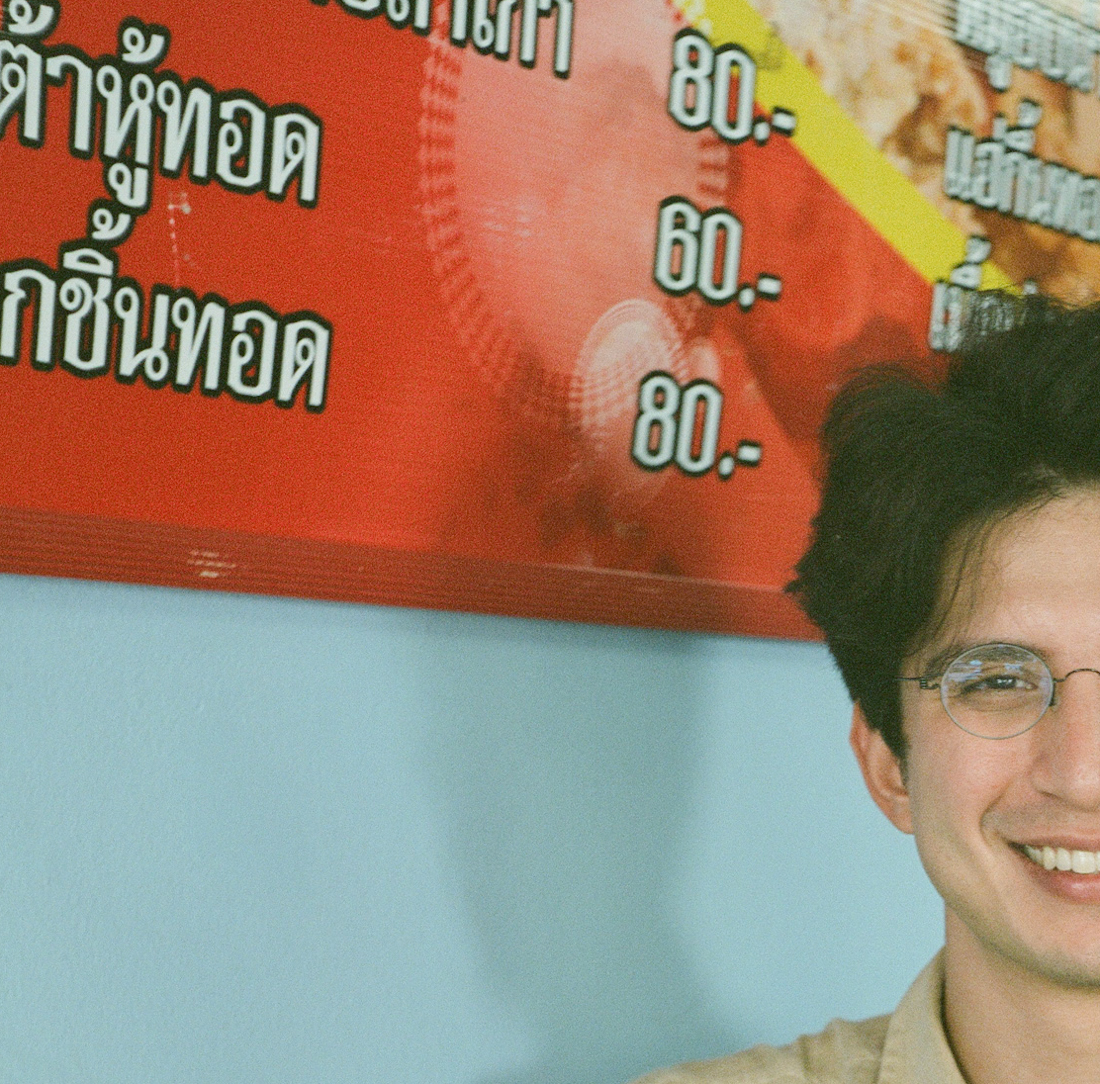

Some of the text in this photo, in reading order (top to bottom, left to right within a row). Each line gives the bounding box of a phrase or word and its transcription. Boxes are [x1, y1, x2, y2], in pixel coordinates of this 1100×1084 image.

[668, 29, 796, 144] 80.-
[0, 205, 331, 408] กชิ้นทอด
[654, 197, 782, 310] 60.-
[632, 372, 761, 480] 80.-
